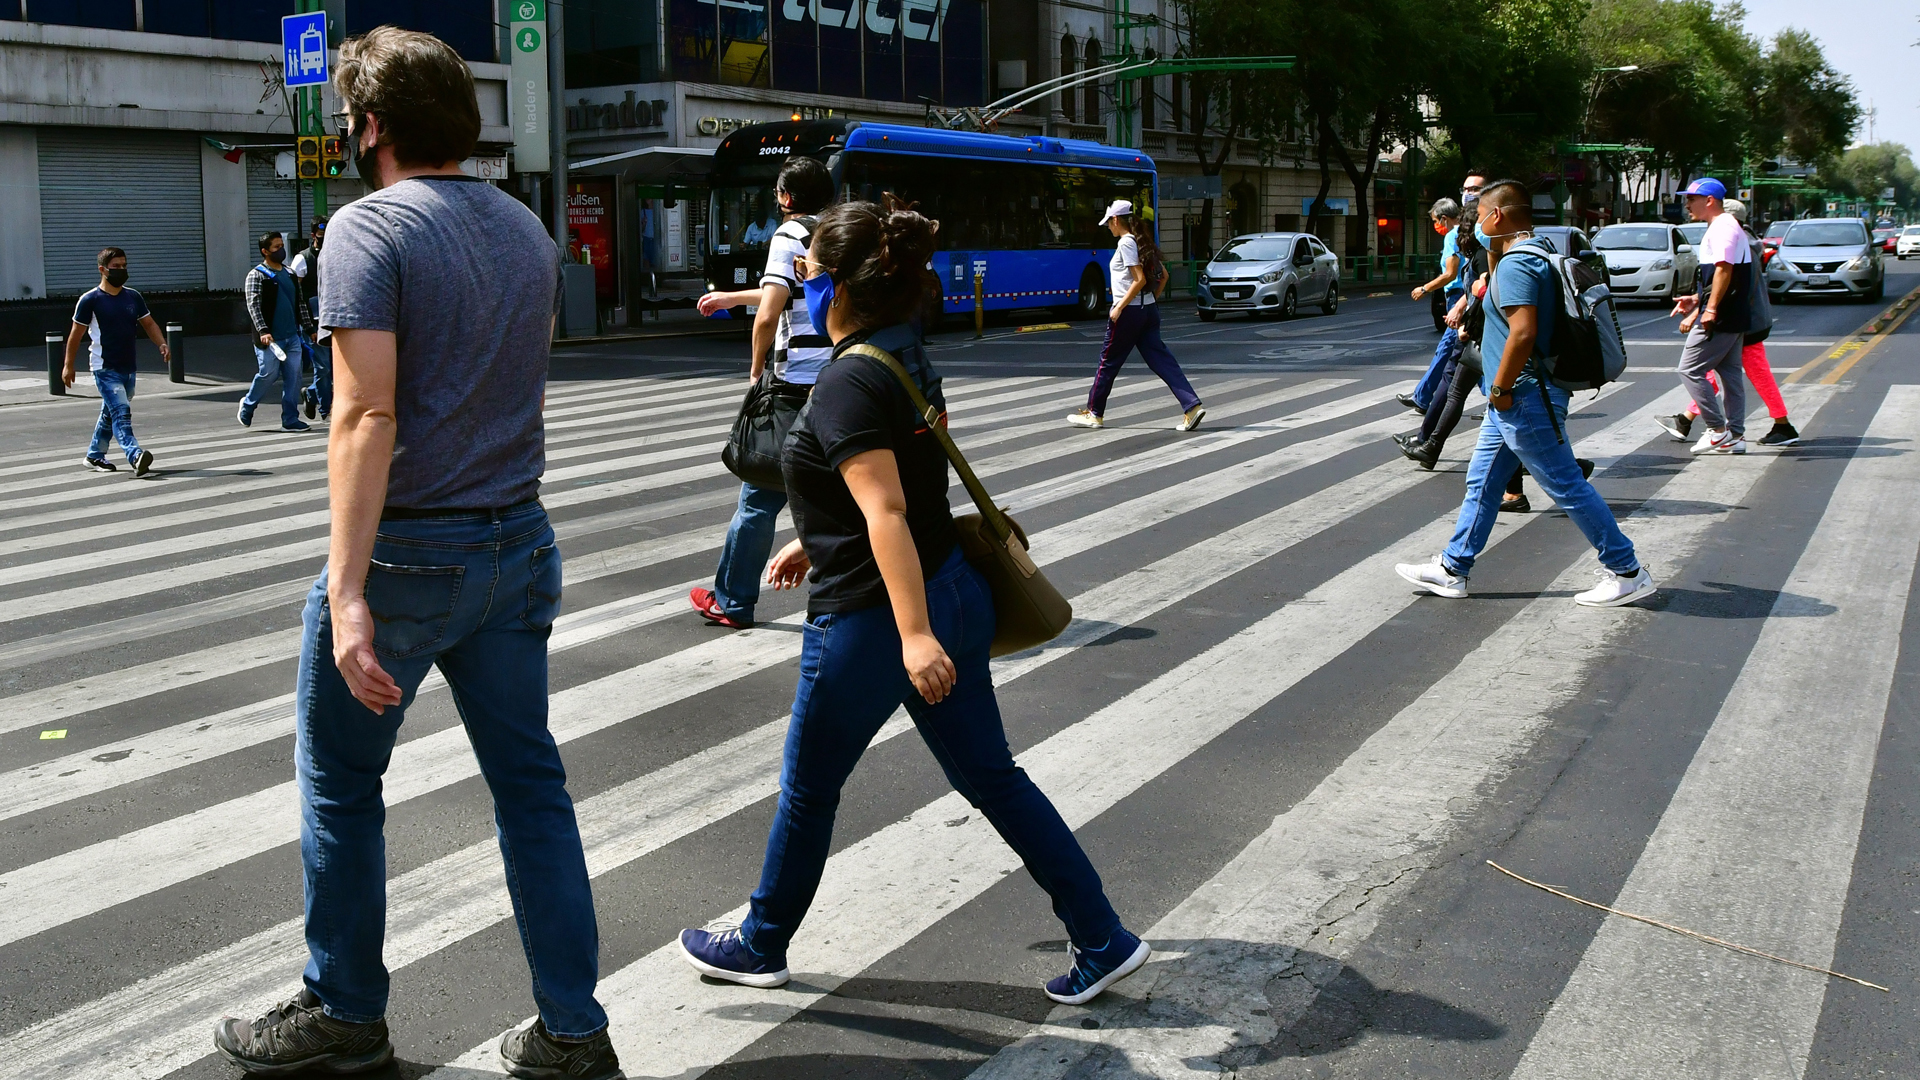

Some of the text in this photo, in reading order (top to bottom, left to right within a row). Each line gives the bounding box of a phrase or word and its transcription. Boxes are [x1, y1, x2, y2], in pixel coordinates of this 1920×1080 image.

[524, 80, 537, 134] Madero
[759, 145, 791, 156] 20042
[567, 207, 604, 216] DONES HECHOS
[573, 216, 598, 224] ALEMANIA
